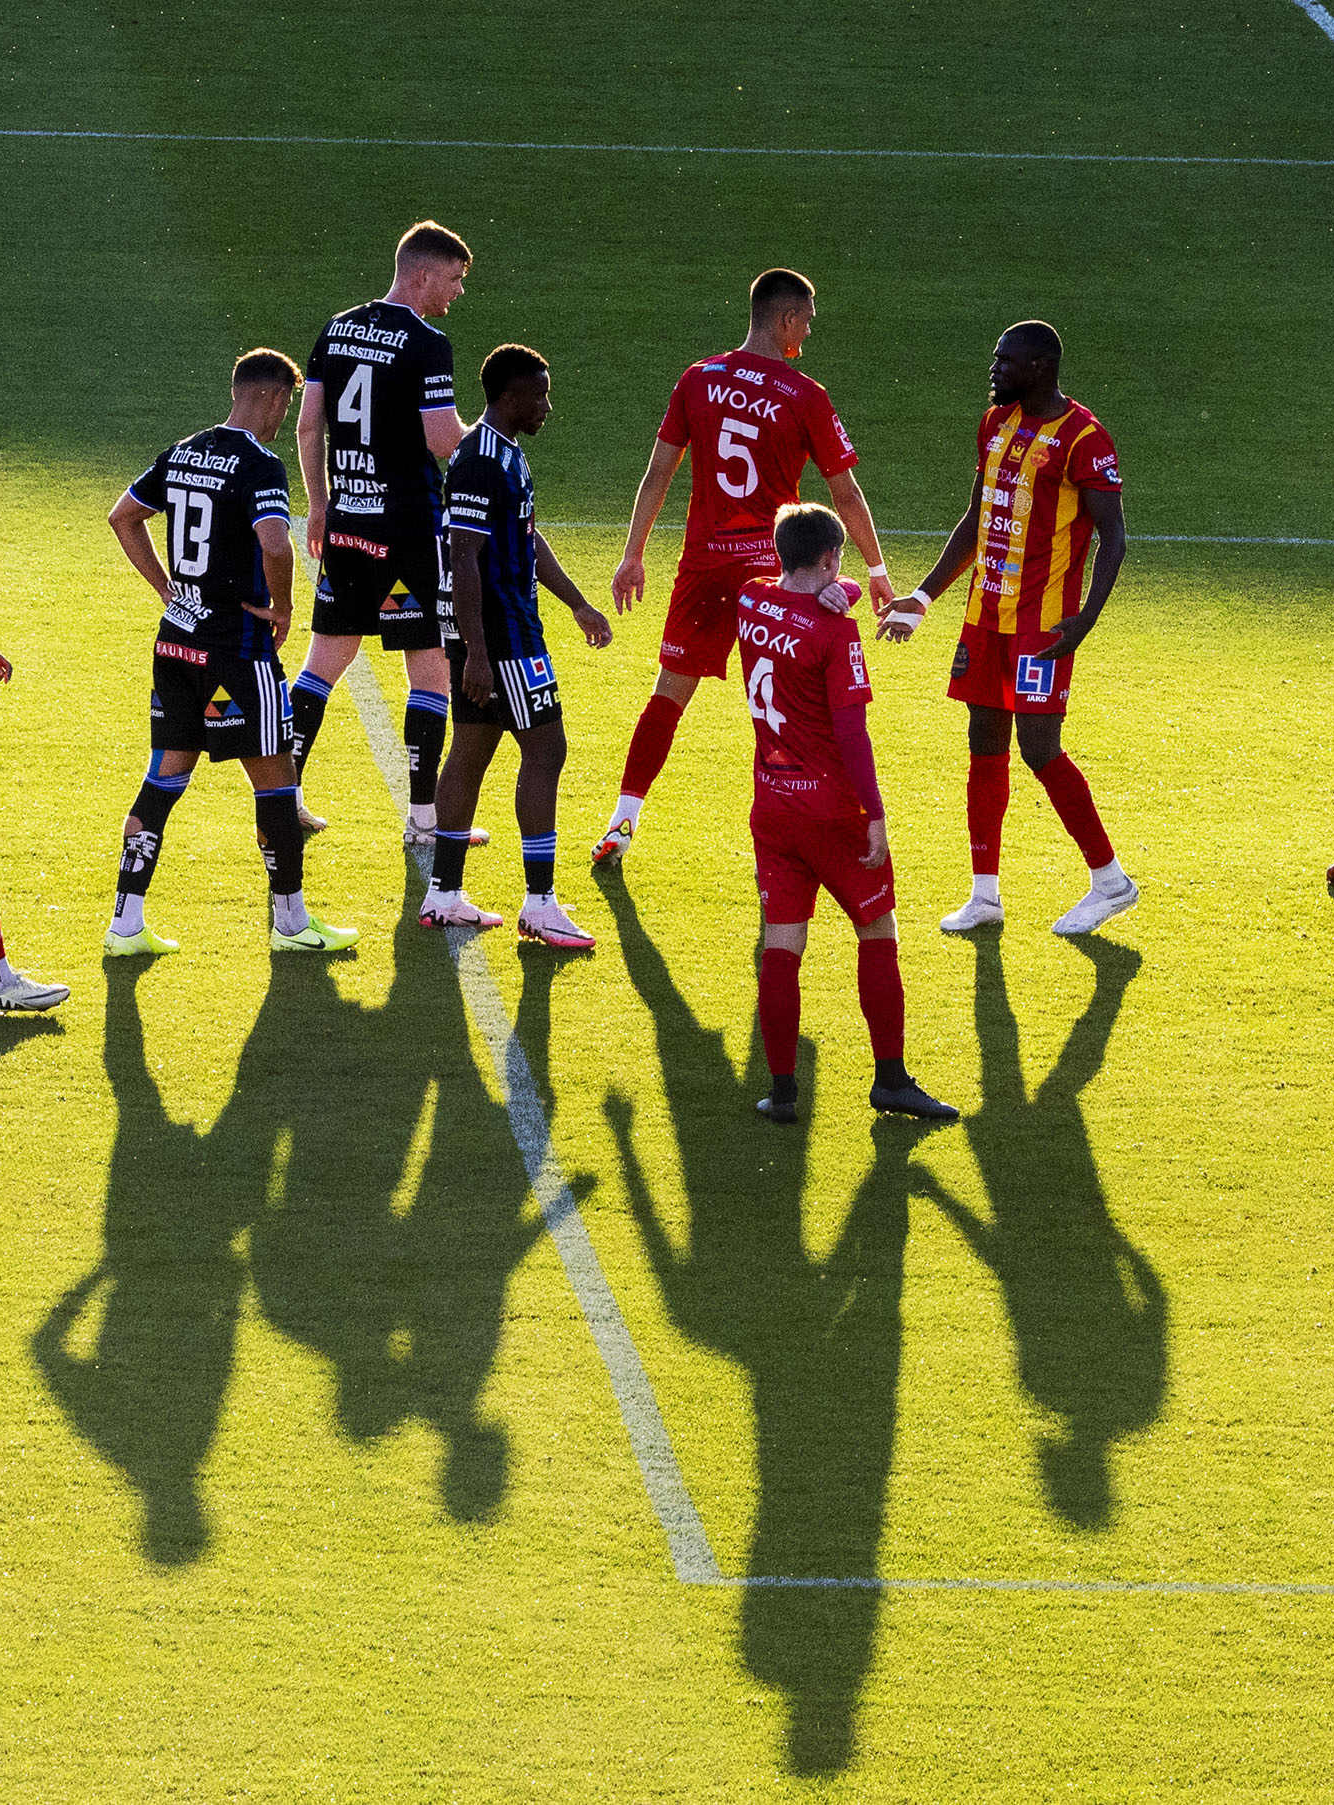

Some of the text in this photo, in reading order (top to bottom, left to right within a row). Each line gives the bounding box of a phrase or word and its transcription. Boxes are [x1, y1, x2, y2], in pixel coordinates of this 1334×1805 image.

[327, 319, 409, 349] Infrakraft
[327, 343, 395, 365] BRASSERIET
[734, 368, 766, 385] OBK
[337, 364, 373, 446] 4
[168, 446, 240, 474] Infrakraft
[335, 450, 376, 475] UTAB
[717, 417, 760, 498] 5
[167, 488, 213, 577] 13
[992, 516, 1023, 535] SKG
[329, 533, 388, 558] BAUHAUS
[379, 611, 424, 620] Ramudden
[759, 601, 787, 618] OBK
[531, 689, 553, 712] 24
[748, 656, 787, 736] 4
[1026, 695, 1048, 703] JAKO
[204, 718, 245, 728] Ramudden
[282, 723, 294, 741] 13
